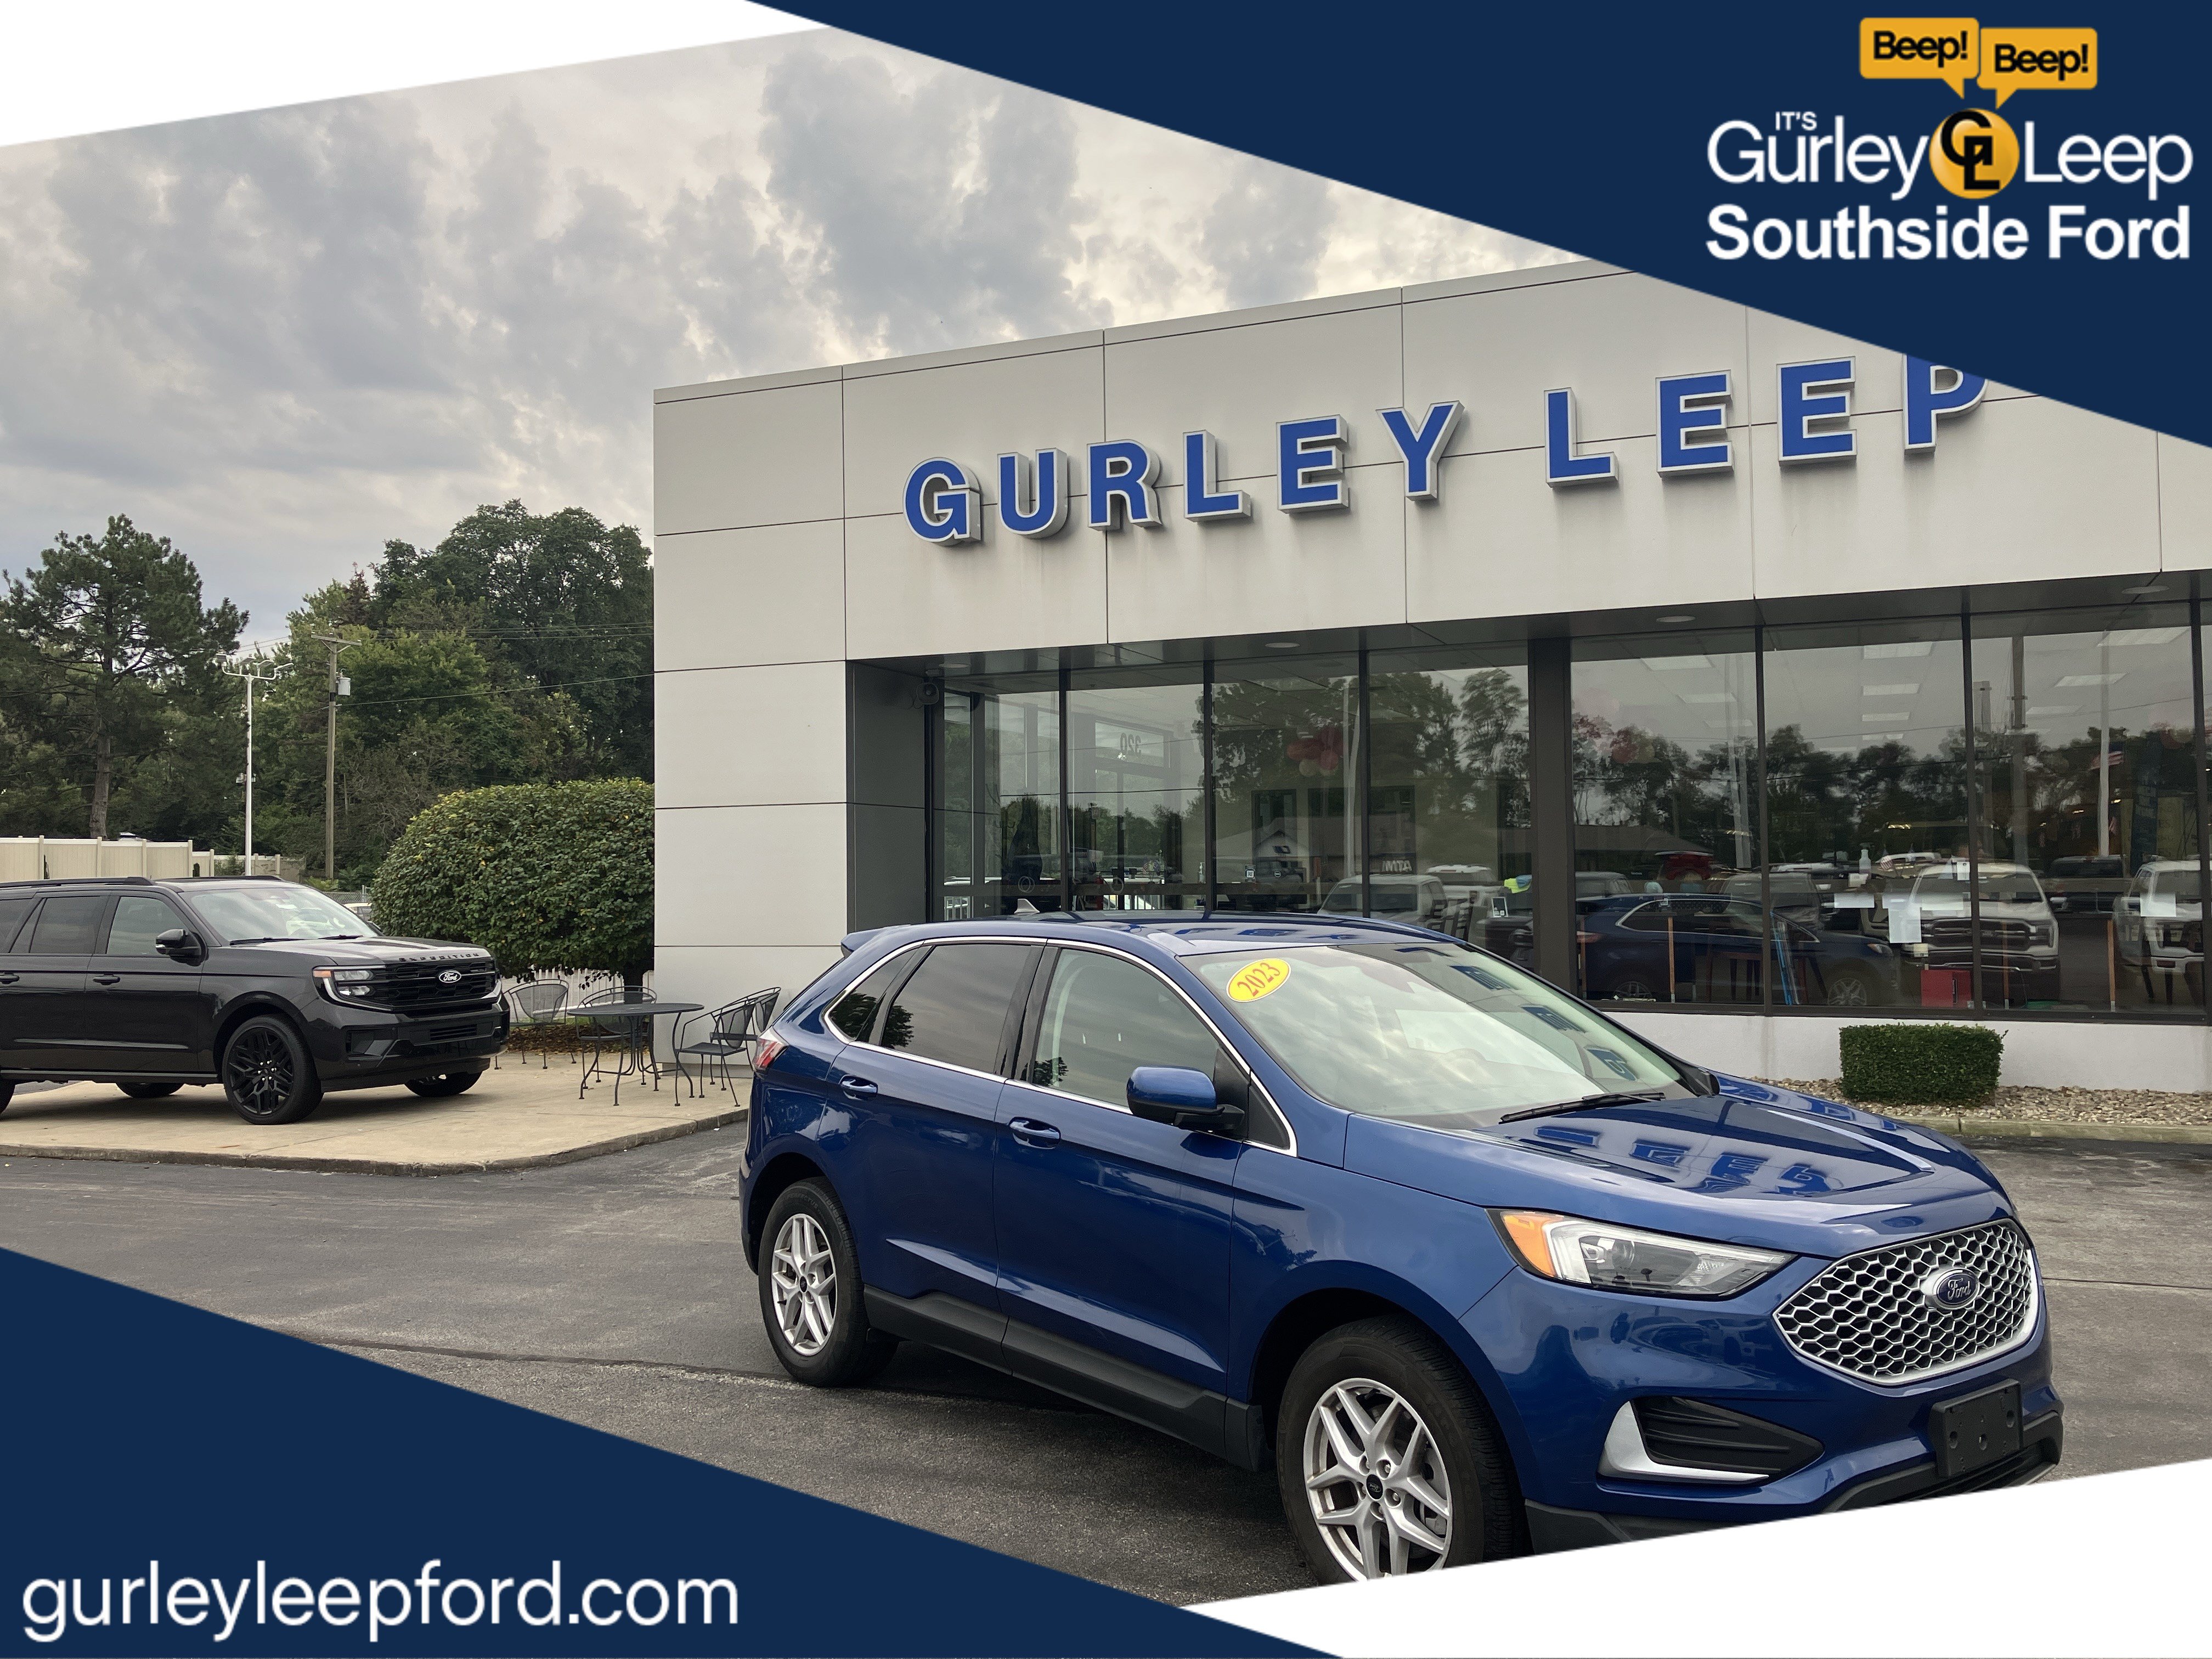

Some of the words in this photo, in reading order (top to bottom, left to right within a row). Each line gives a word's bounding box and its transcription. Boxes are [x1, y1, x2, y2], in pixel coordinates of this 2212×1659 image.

[902, 400, 1464, 545] GURLEY
[1544, 353, 1988, 488] LEEP
[443, 973, 458, 981] Ford
[1237, 962, 1280, 997] 2023
[1948, 1278, 1972, 1300] Ford
